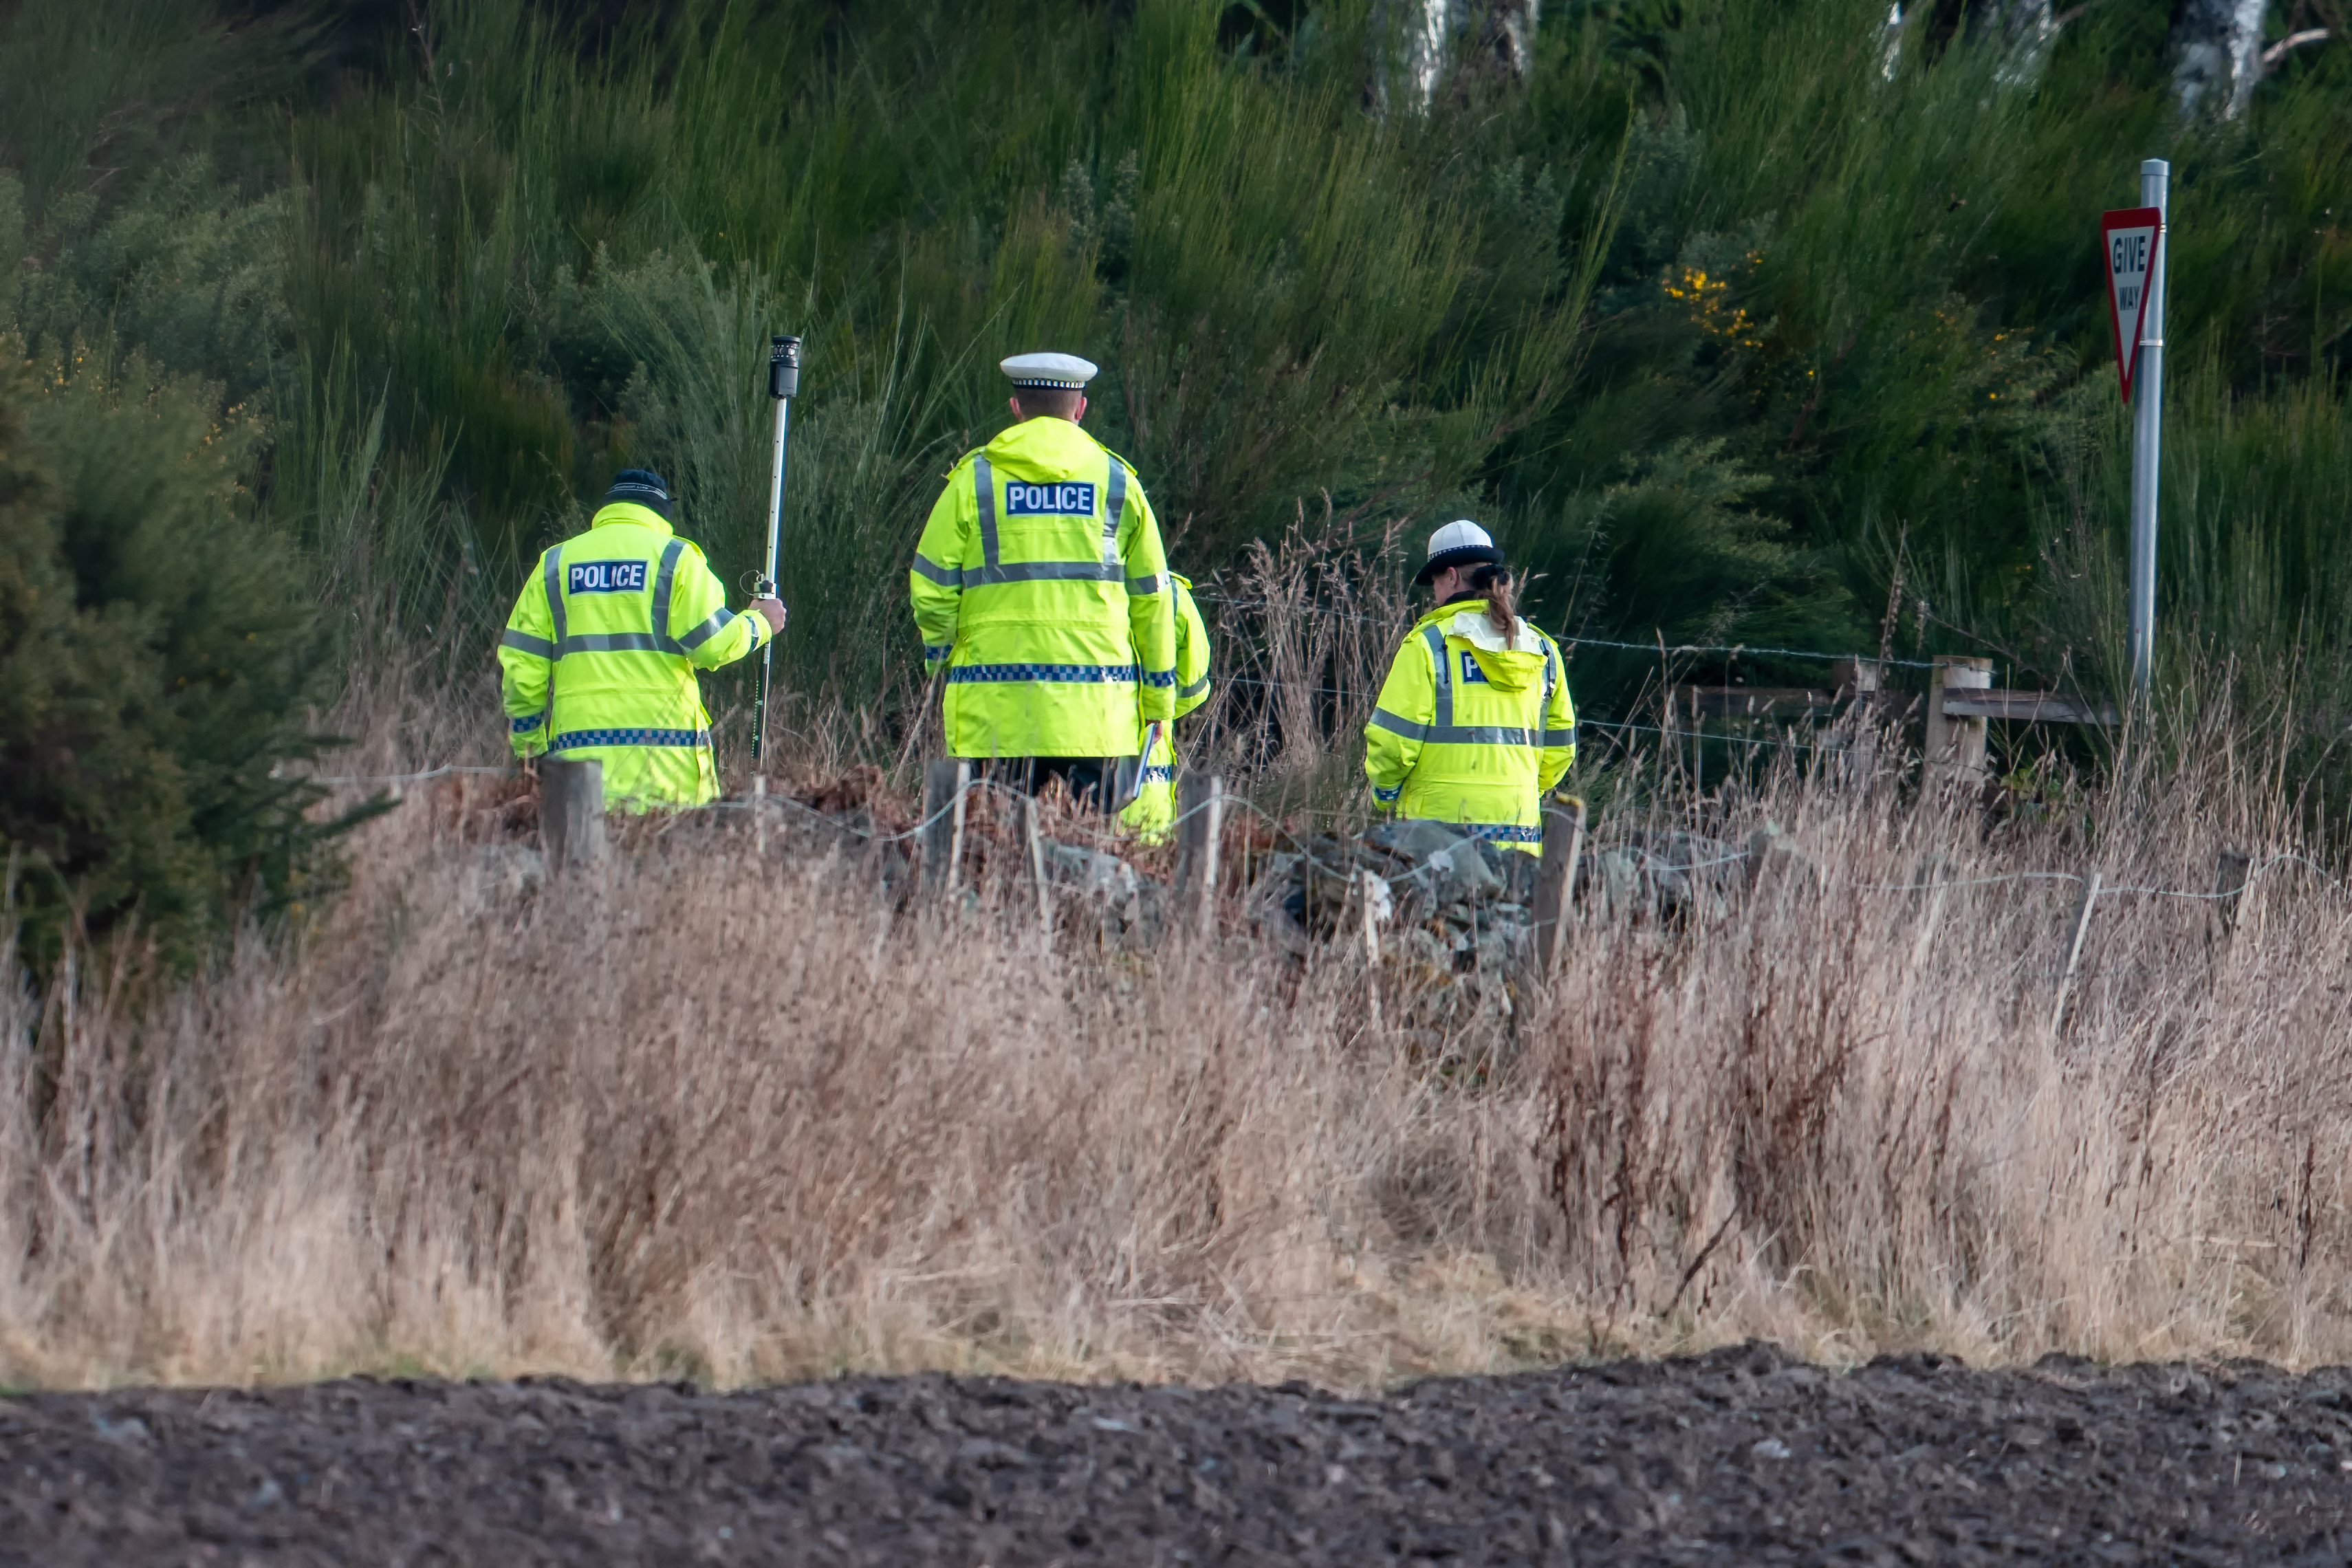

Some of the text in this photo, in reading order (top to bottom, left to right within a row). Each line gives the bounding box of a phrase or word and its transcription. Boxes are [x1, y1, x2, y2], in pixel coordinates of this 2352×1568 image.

[2113, 236, 2146, 274] GIVE
[2119, 286, 2139, 311] WAY
[1009, 486, 1091, 511] POLICE
[571, 565, 643, 589] POLICE
